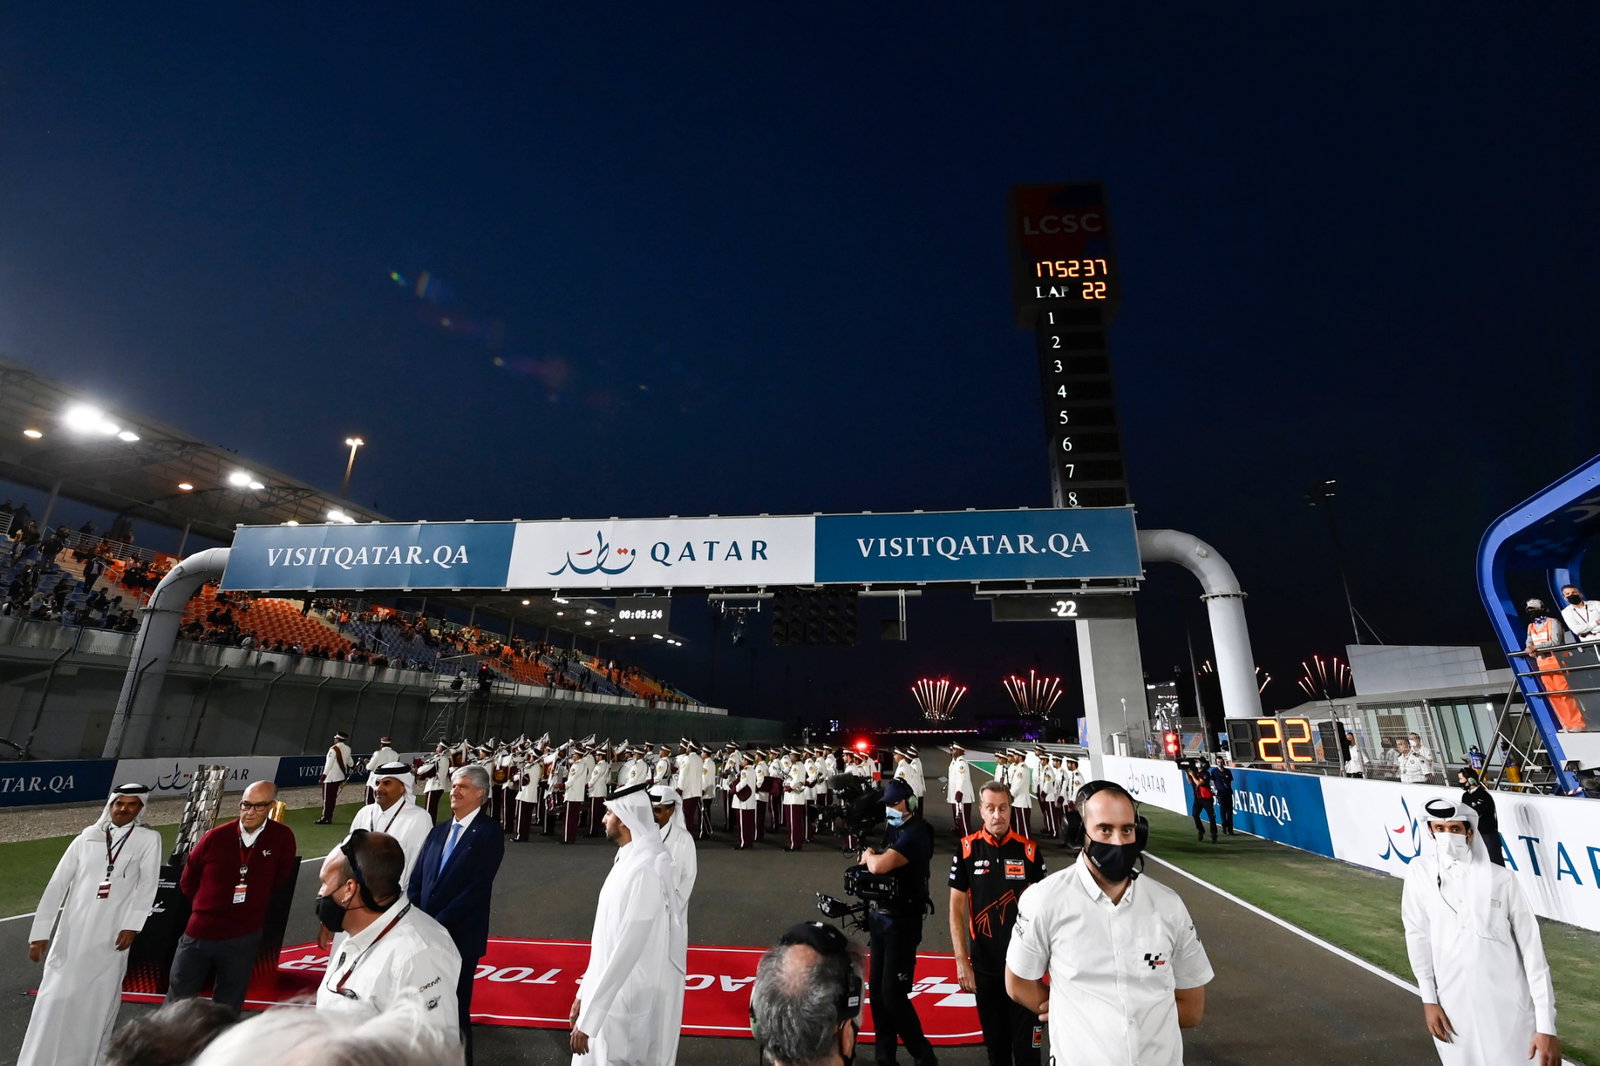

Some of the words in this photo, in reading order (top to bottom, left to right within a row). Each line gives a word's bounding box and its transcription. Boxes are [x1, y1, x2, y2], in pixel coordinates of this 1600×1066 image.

[1023, 213, 1102, 235] LCSC
[1035, 285, 1069, 298] LAP
[1082, 281, 1106, 299] 22
[1048, 312, 1055, 324] 1
[1051, 336, 1061, 348] 2
[1054, 360, 1063, 373] 3
[1057, 385, 1067, 398] 4
[1060, 410, 1068, 424] 5
[1062, 437, 1072, 451] 6
[1065, 464, 1074, 478] 7
[1068, 492, 1077, 507] 8
[650, 540, 768, 567] QATAR
[856, 533, 1090, 561] VISITQATAR.QA
[267, 545, 469, 570] VISITQATAR.QA
[618, 610, 663, 620] 00:05:24
[1050, 601, 1078, 617] -22
[1257, 719, 1312, 762] 22
[1141, 776, 1167, 793] QATAR
